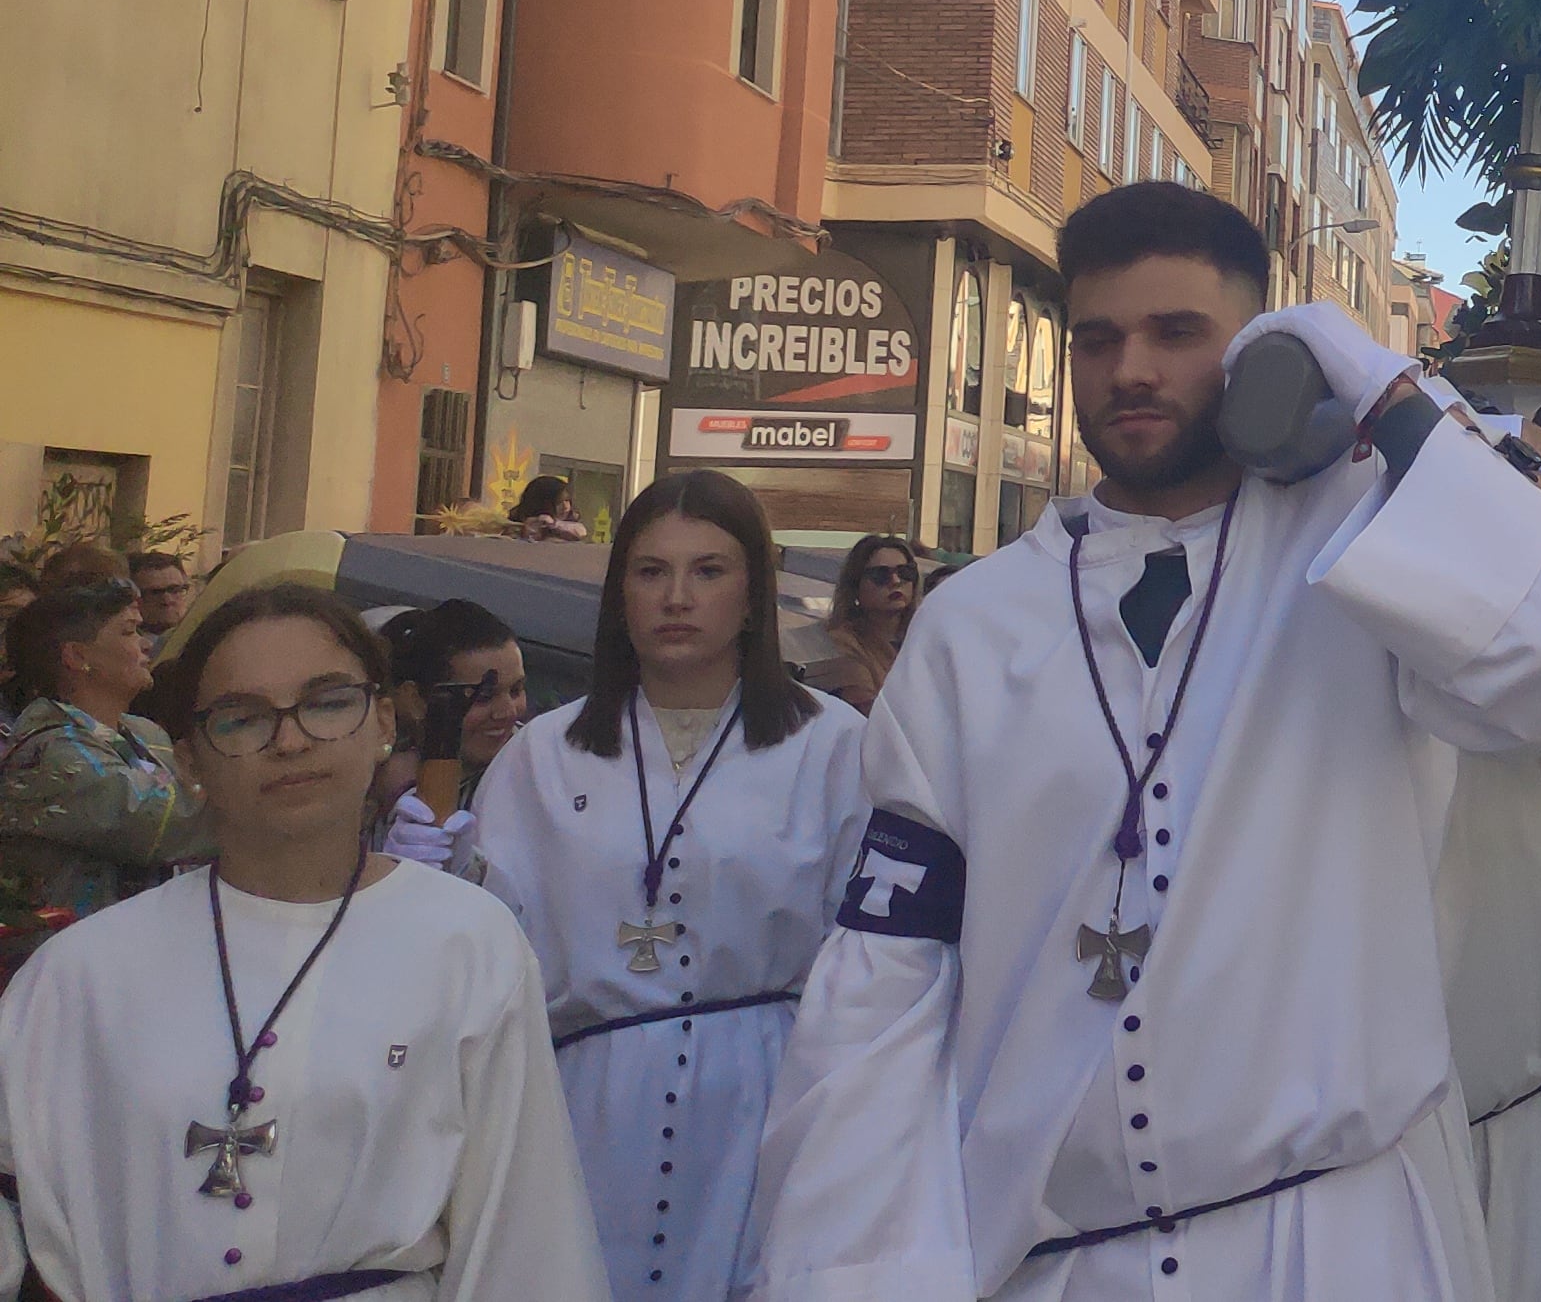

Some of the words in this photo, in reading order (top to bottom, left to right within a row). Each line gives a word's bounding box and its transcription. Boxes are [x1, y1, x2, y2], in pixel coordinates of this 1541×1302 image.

[729, 275, 882, 318] PRECIOS
[690, 320, 911, 376] INCREIBLES
[751, 422, 836, 447] mabel
